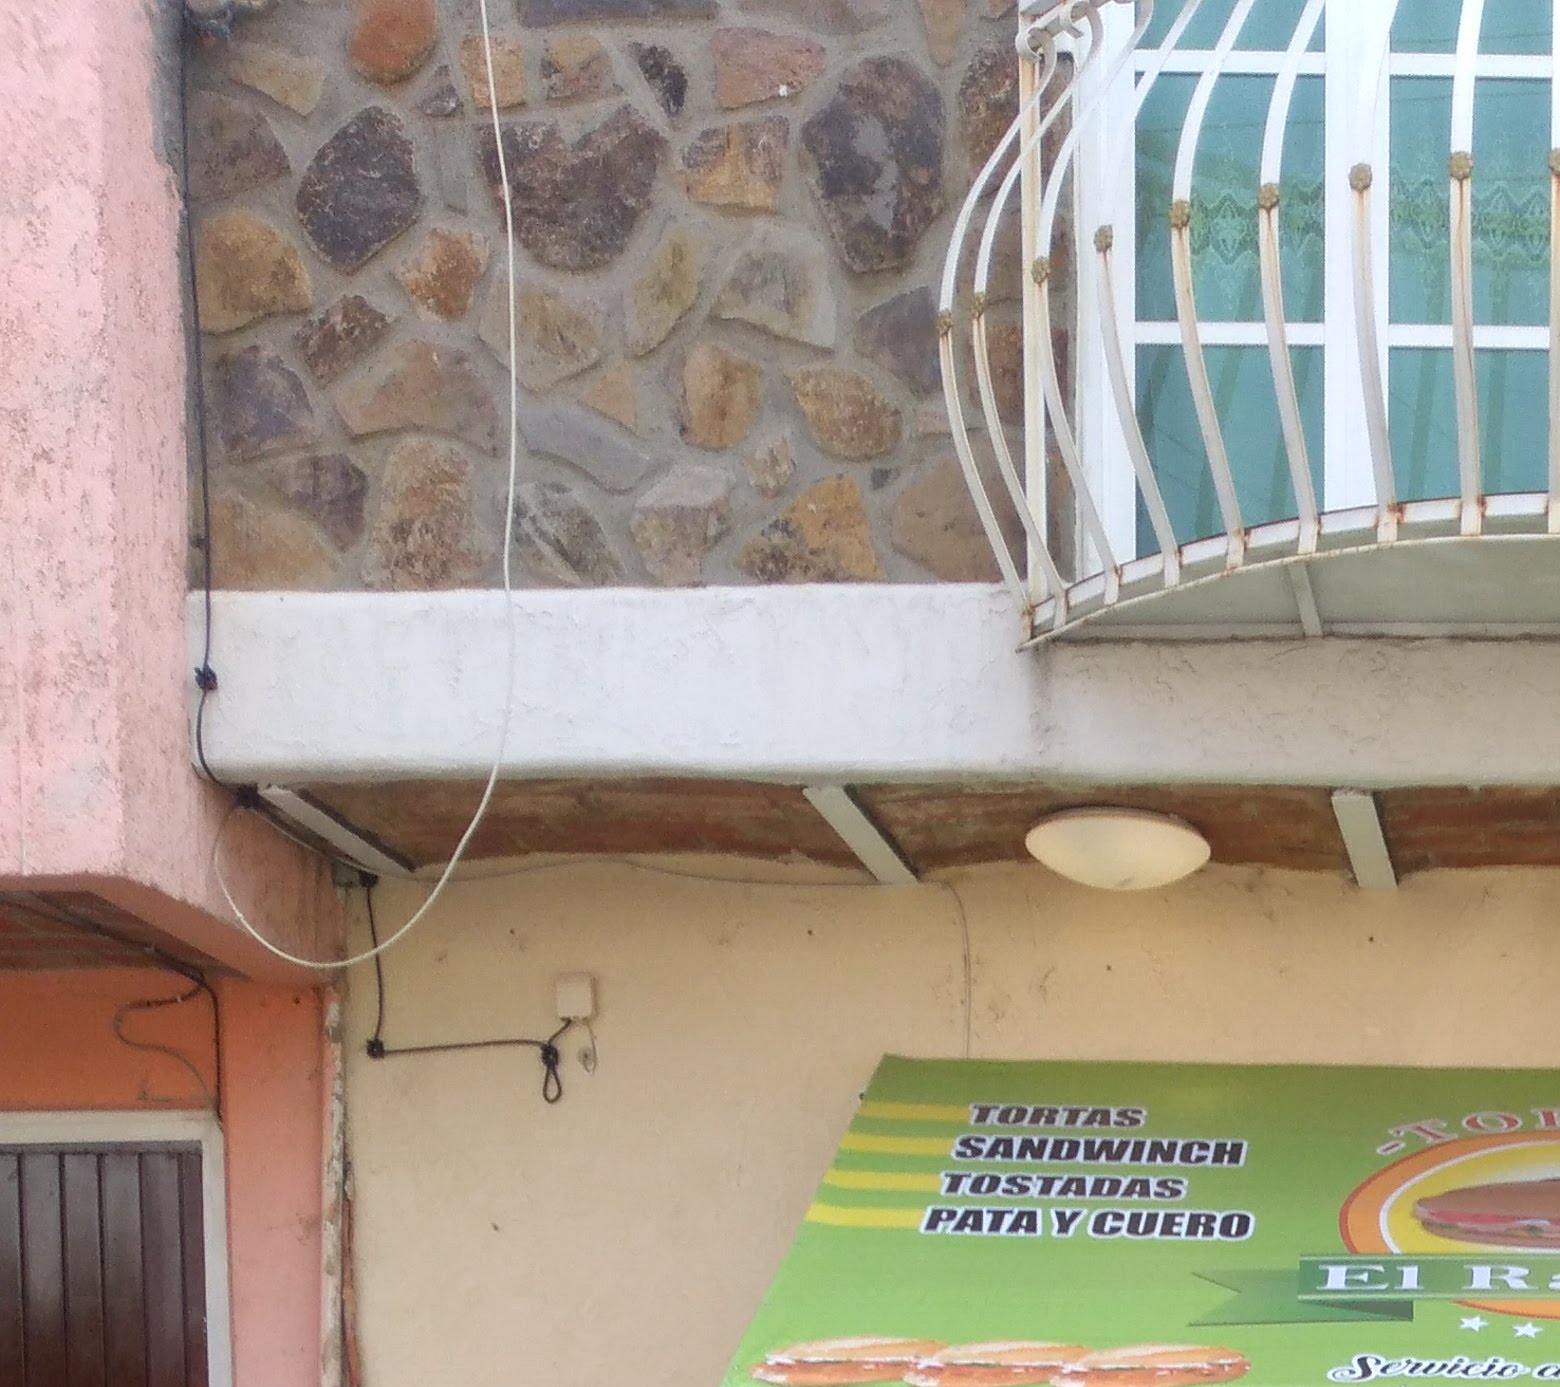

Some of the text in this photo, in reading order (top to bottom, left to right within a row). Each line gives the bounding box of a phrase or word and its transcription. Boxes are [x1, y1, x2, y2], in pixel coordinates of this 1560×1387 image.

[971, 1103, 1147, 1128] TORTAS
[953, 1135, 1247, 1166] SANDWINCH
[940, 1171, 1189, 1200] TOSTADAS
[921, 1207, 1255, 1240] PATA Y CUERO
[1317, 1263, 1423, 1291] El
[1327, 1353, 1525, 1383] Servicio
